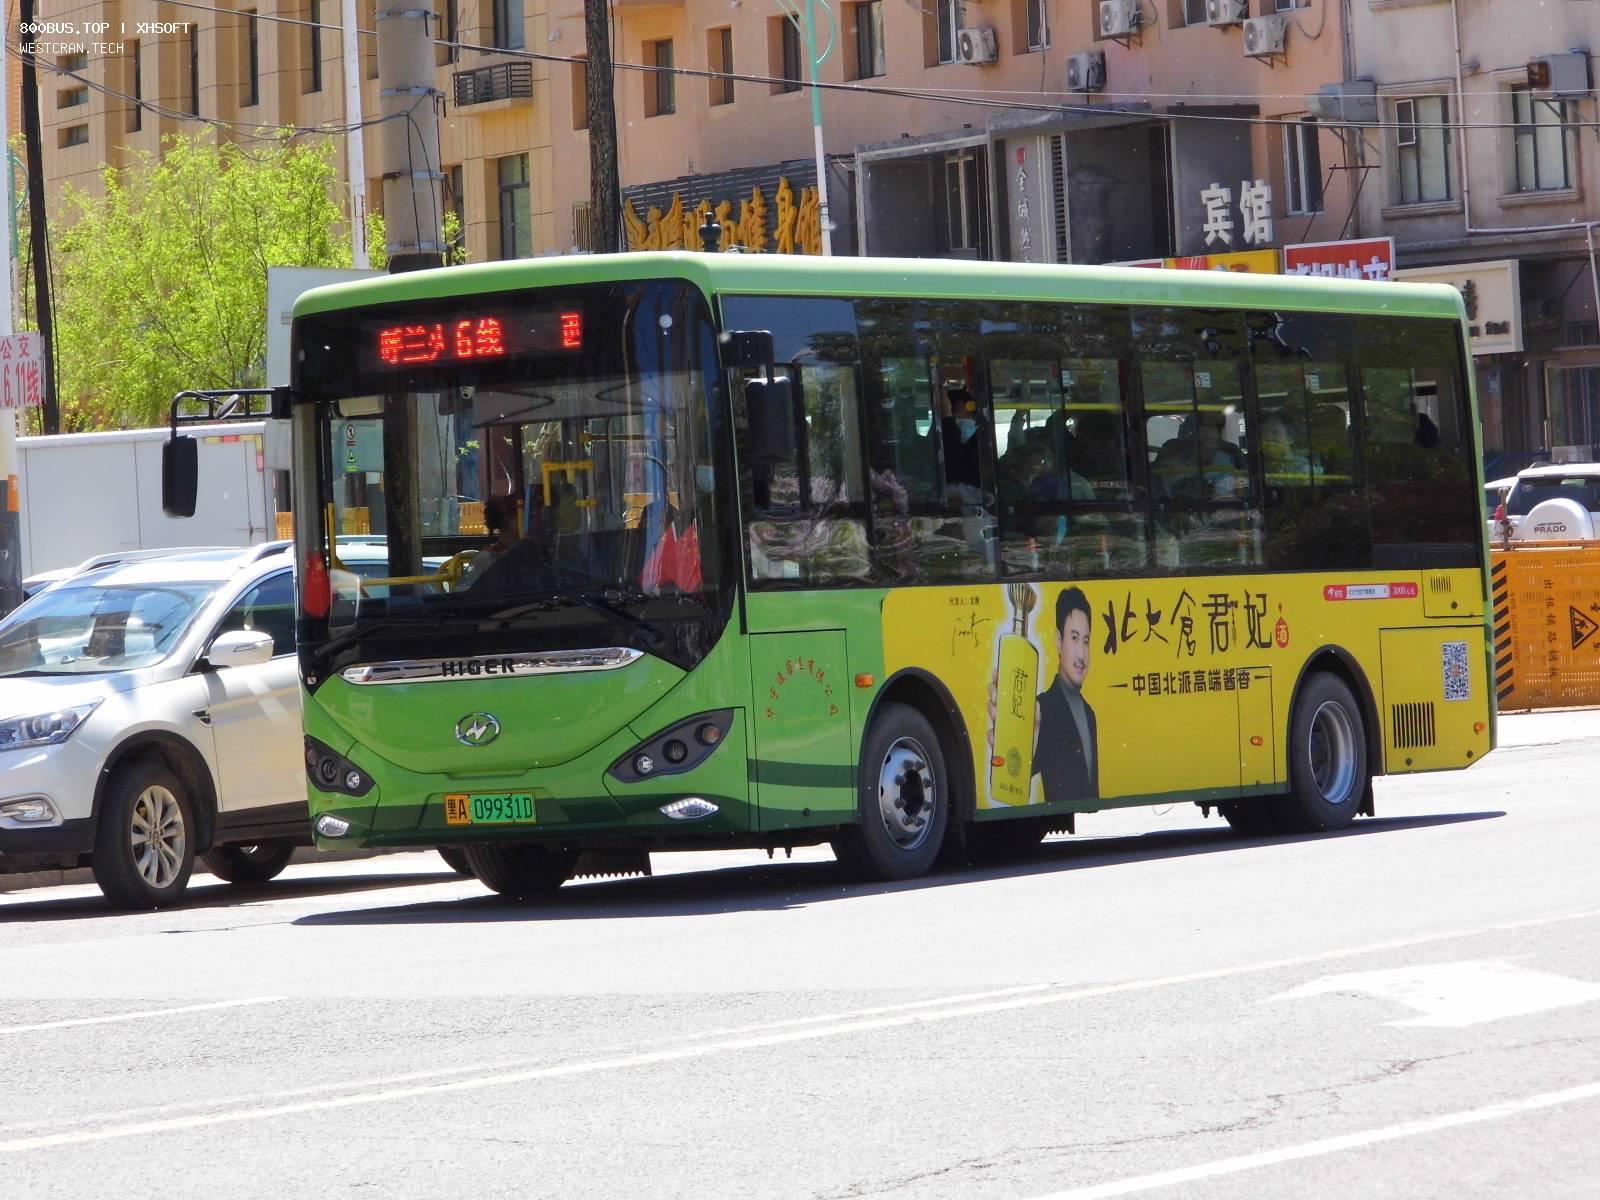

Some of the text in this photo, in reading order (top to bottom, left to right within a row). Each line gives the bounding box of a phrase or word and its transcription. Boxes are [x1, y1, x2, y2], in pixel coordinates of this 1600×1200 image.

[1200, 179, 1273, 246] 宾馆
[0, 335, 30, 360] 公交
[1534, 525, 1567, 534] PRADO
[441, 657, 516, 677] HIGER
[1132, 667, 1251, 697] 中国北派高端酱香
